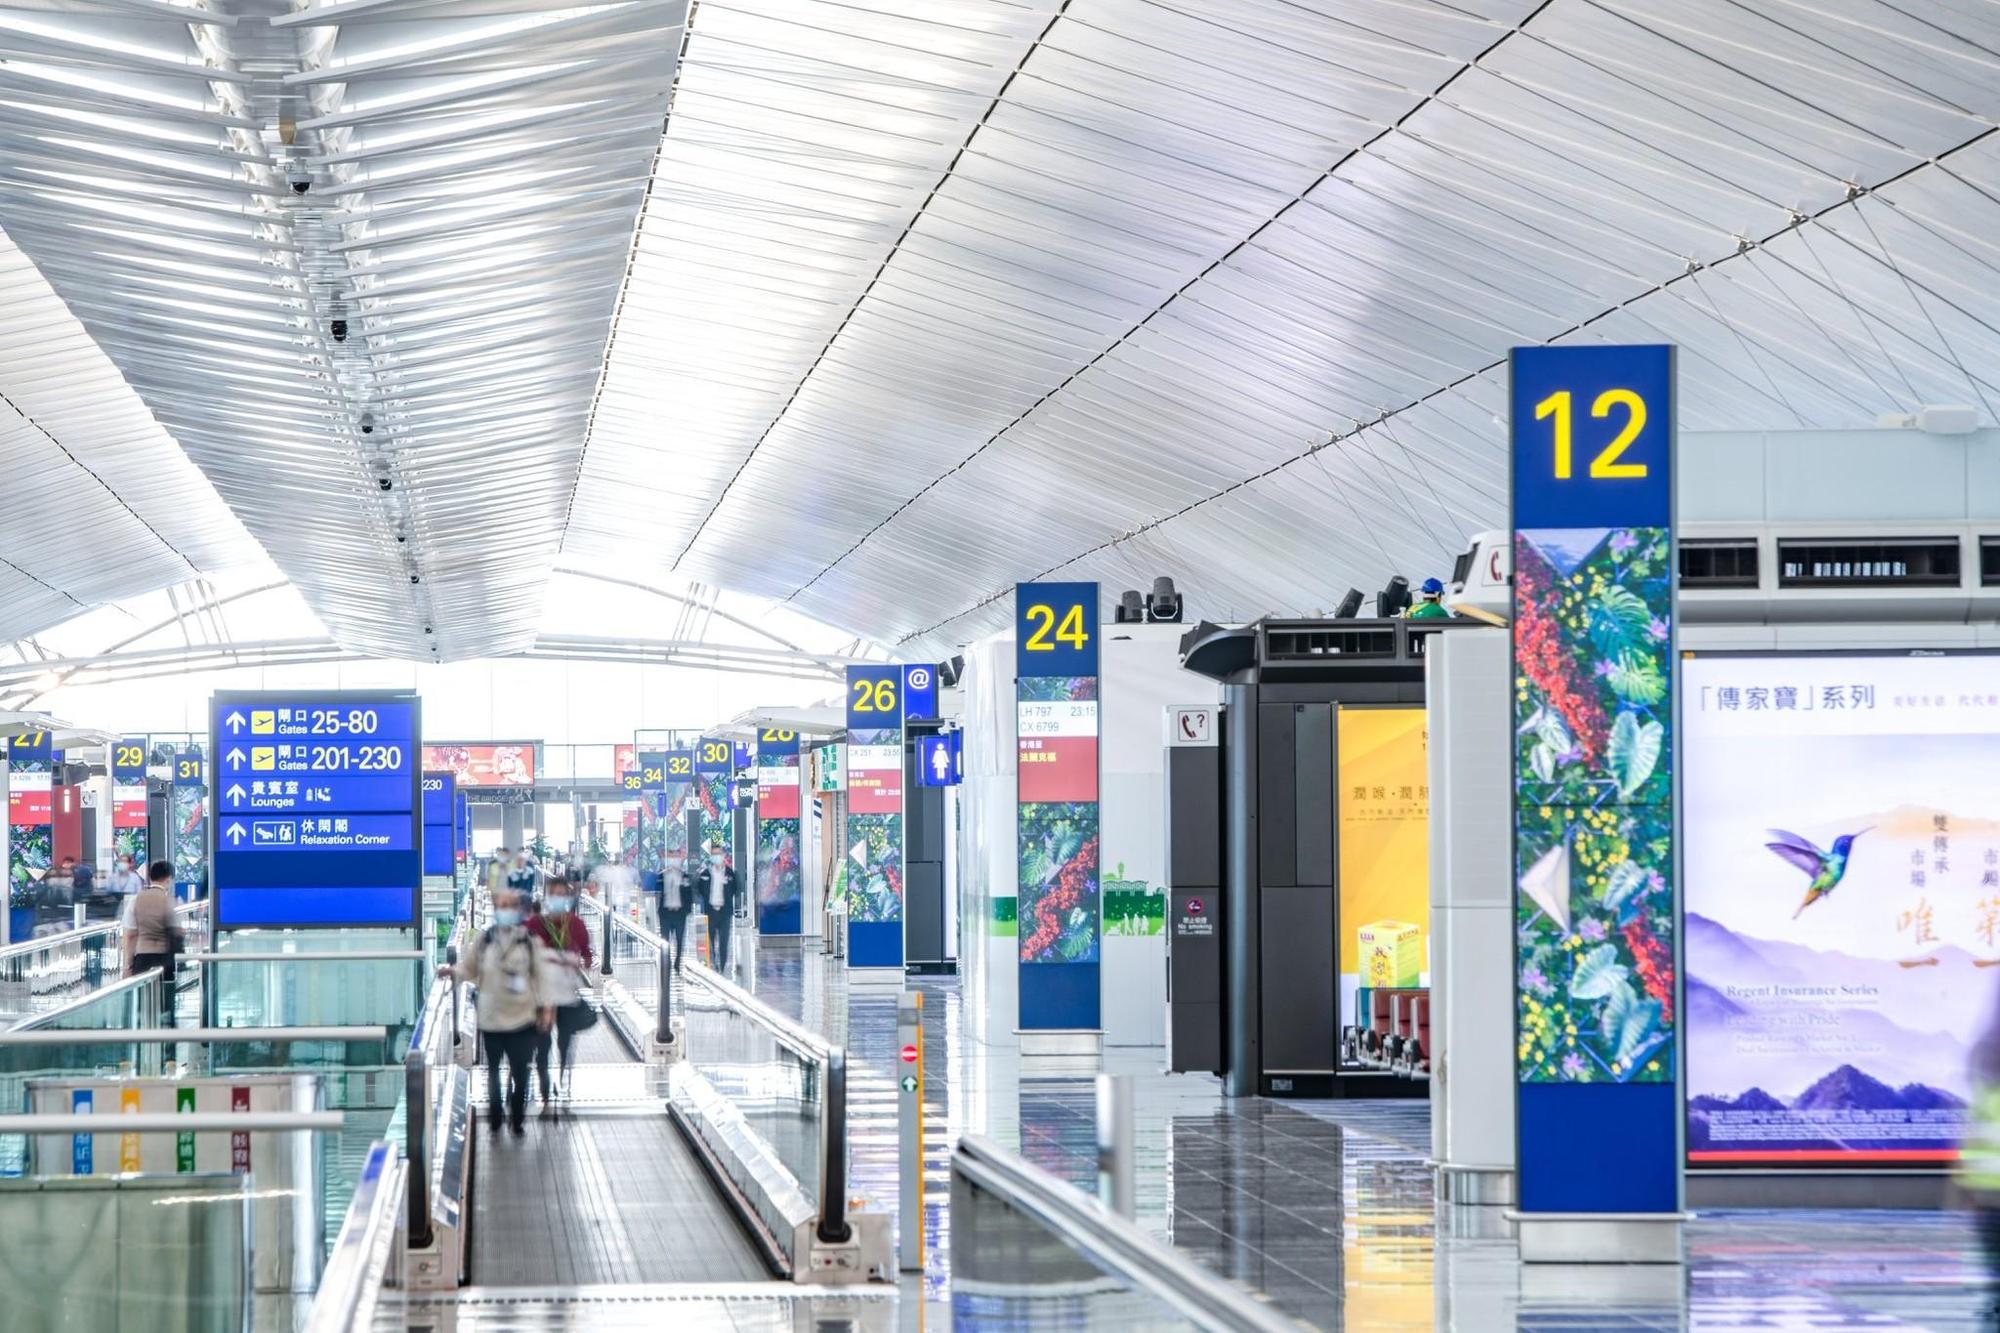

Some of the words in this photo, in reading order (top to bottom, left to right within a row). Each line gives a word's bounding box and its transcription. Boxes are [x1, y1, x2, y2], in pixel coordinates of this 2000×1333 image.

[1535, 389, 1647, 479] 12
[1026, 604, 1088, 651] 24
[853, 679, 895, 711] 26
[278, 709, 307, 723] 閘口
[1019, 706, 1033, 717] LH
[1035, 706, 1052, 717] 797
[1070, 706, 1096, 717] 23:15
[278, 724, 308, 734] Gates
[311, 710, 378, 734] 25-80
[1019, 721, 1034, 732] CX
[1036, 721, 1059, 732] 6799
[116, 747, 143, 767] 29
[278, 745, 307, 759] 閘口
[278, 761, 308, 770] Gates
[311, 746, 402, 770] 201-230
[703, 743, 728, 763] 30
[179, 761, 199, 778] 31
[668, 757, 690, 774] 32
[624, 776, 641, 790] 36
[644, 768, 663, 783] 34
[251, 781, 299, 795] 貴賓室
[251, 797, 295, 808] Lounges
[300, 835, 353, 845] Relaxation
[355, 834, 390, 845] Corner
[1727, 985, 1769, 998] Regent
[1775, 985, 1837, 996] Insurance
[1840, 984, 1879, 996] Series
